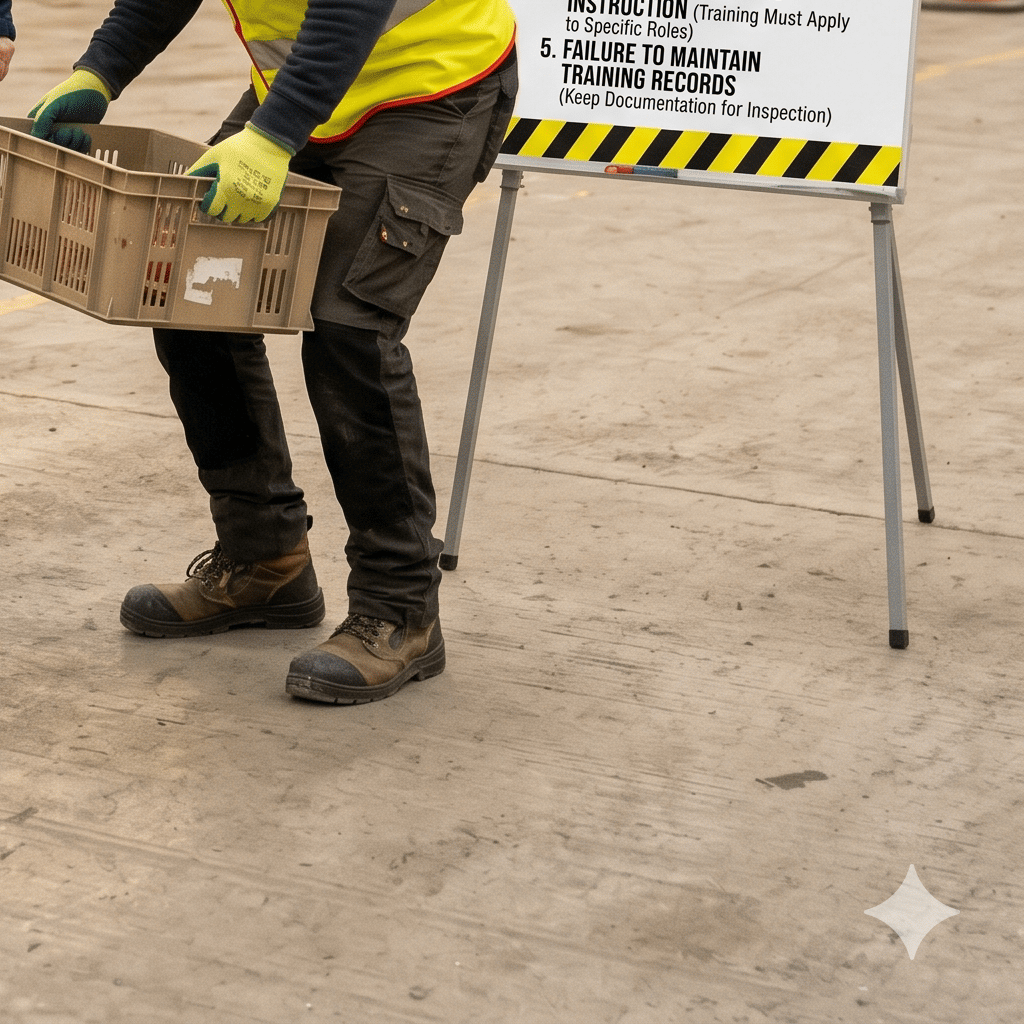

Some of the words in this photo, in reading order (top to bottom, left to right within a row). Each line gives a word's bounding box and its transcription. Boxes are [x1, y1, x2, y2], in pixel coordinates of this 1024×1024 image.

[565, 16, 579, 32] to
[584, 16, 642, 37] Specific
[647, 20, 693, 43] Roles)
[693, 4, 759, 28] (Training
[764, 8, 803, 26] Must
[806, 11, 850, 33] Apply
[540, 37, 556, 58] 5.
[563, 38, 637, 64] FAILURE
[642, 44, 665, 66] TO
[670, 46, 761, 72] MAINTAIN
[561, 63, 646, 90] TRAINING
[651, 69, 736, 96] RECORDS
[559, 87, 600, 110] (Keep
[605, 90, 716, 115] Documentation
[721, 99, 743, 117] for
[747, 101, 832, 128] Inspection)
